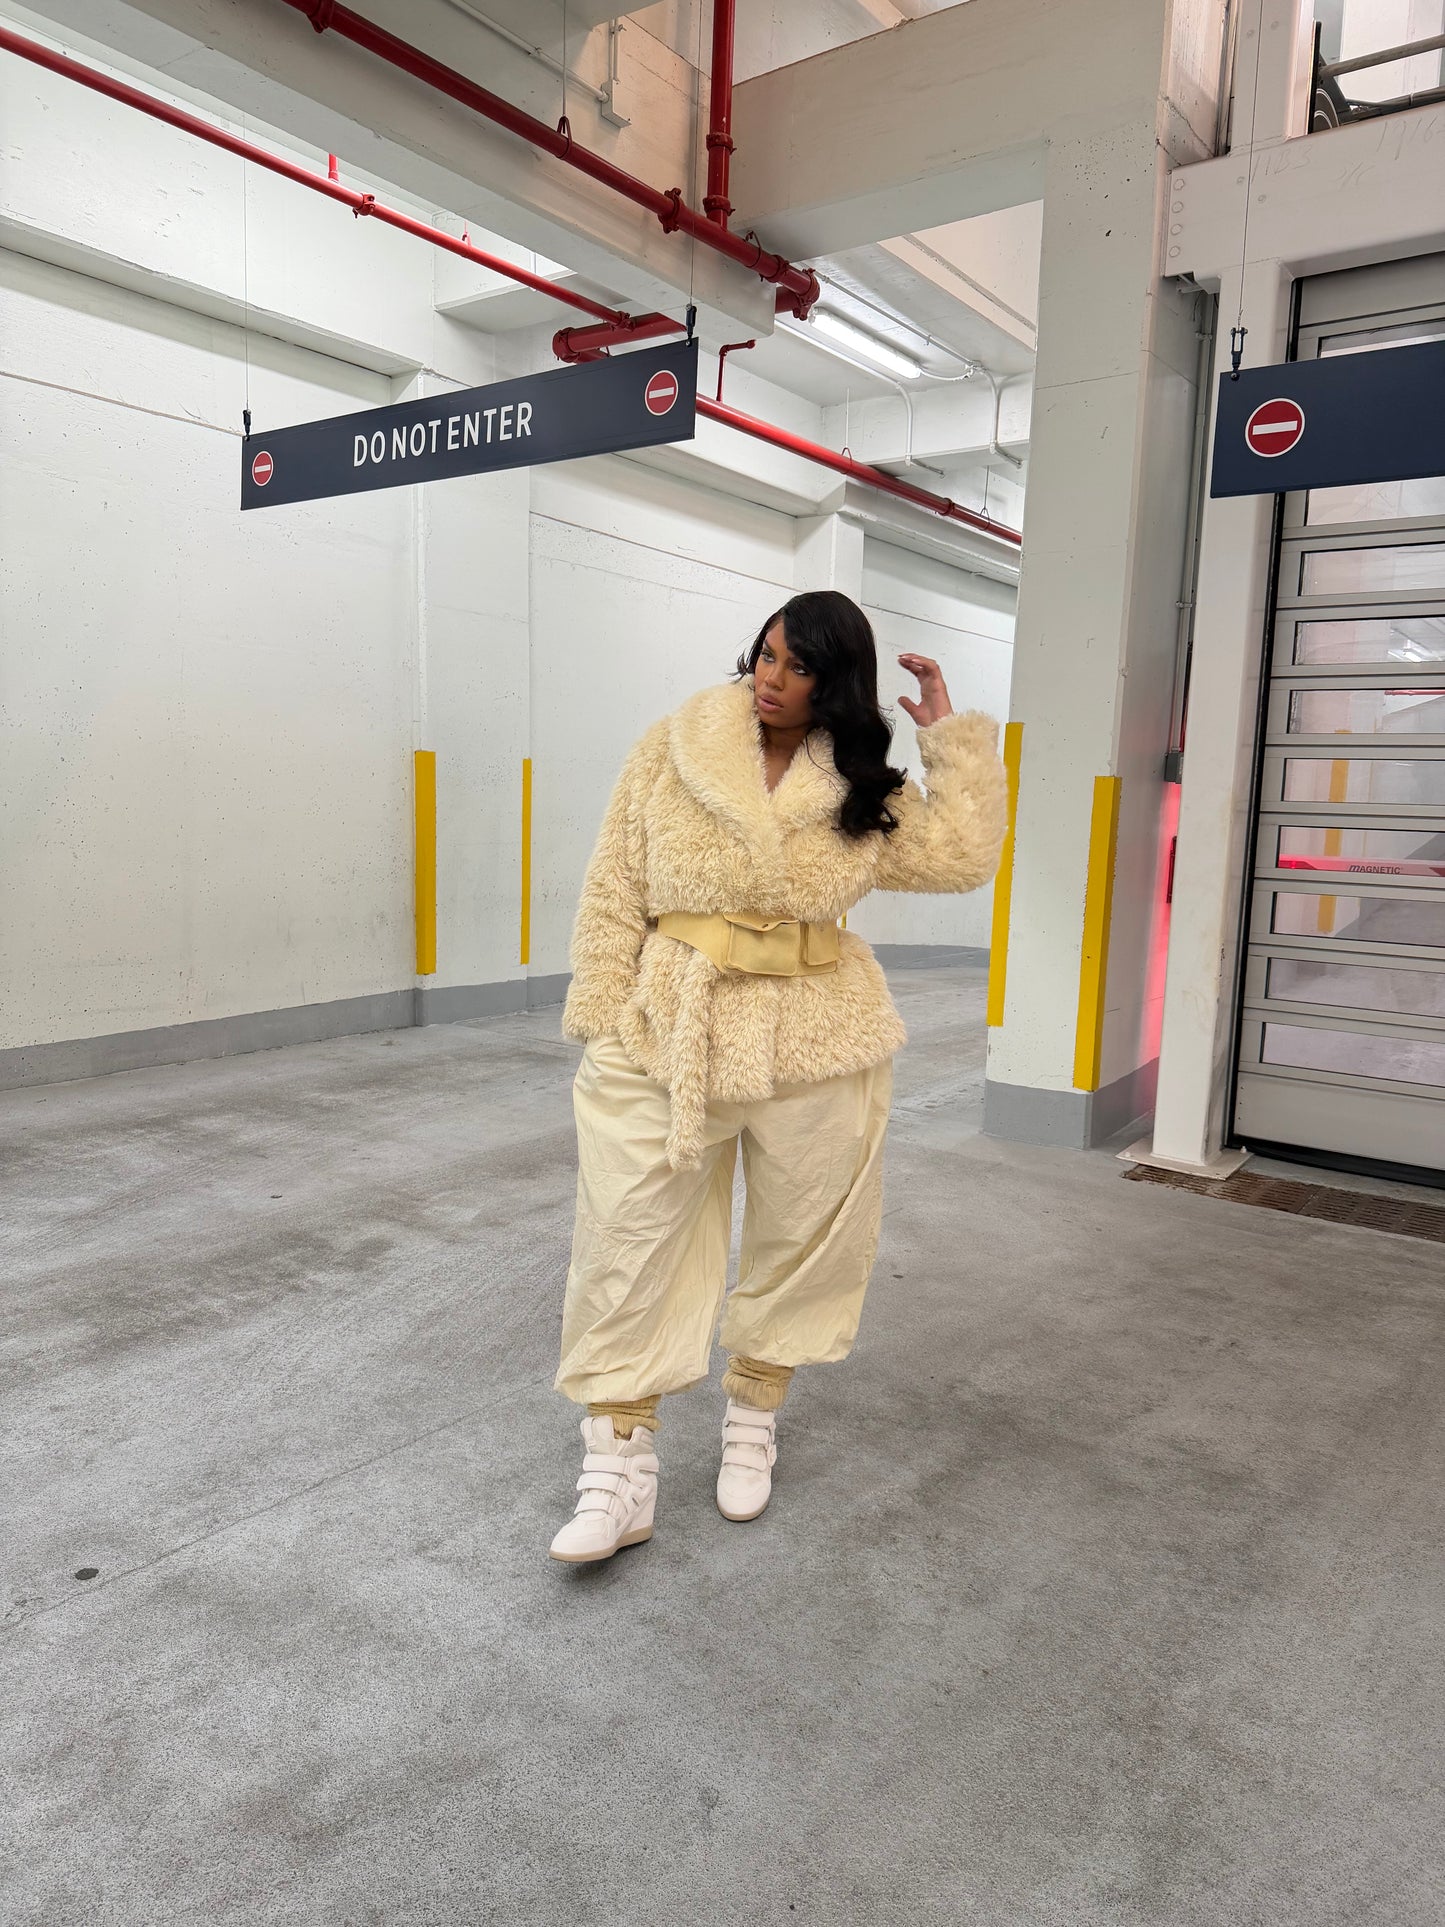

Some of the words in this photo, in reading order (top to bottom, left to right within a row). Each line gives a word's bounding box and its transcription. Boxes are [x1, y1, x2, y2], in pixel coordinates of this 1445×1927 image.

[353, 430, 386, 467] DO
[391, 419, 442, 460] NOT
[447, 401, 533, 451] ENTER
